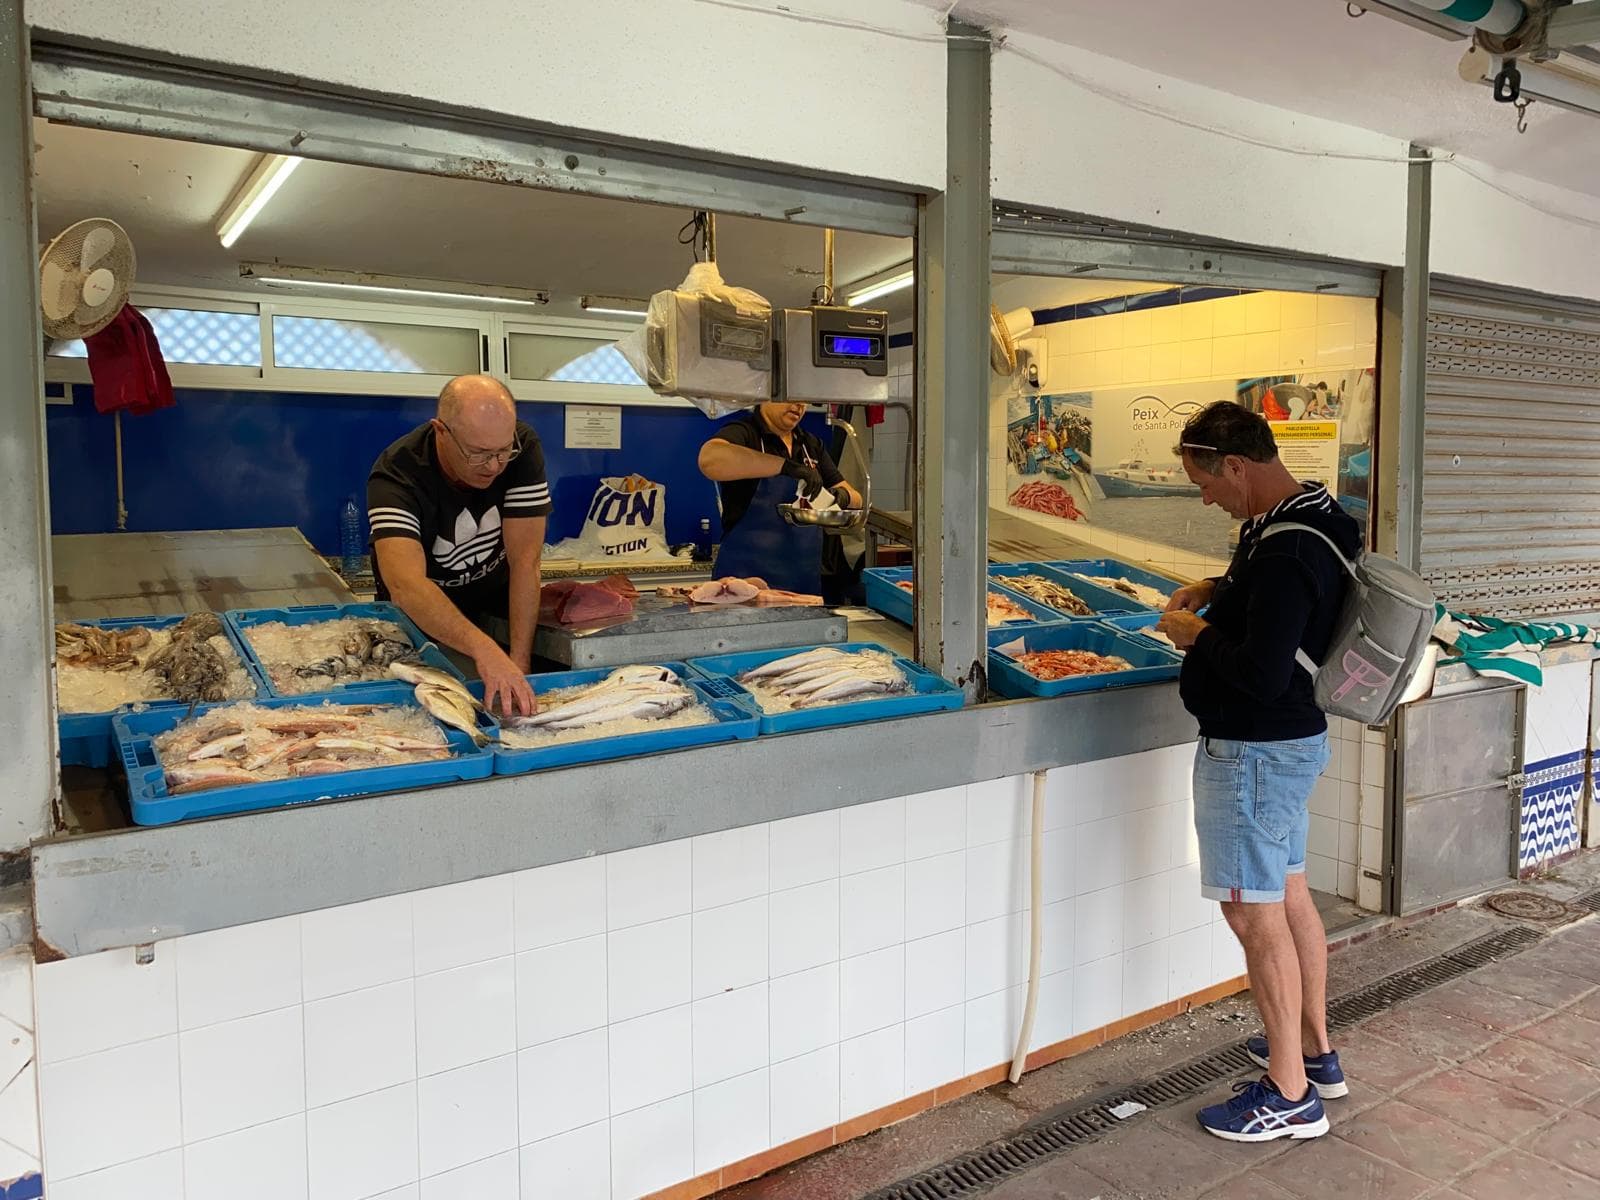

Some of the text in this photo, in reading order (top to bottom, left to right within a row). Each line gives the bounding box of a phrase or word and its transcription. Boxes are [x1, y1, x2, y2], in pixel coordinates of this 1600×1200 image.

[1133, 407, 1159, 421] Peix
[1133, 422, 1143, 431] de
[1145, 421, 1167, 430] Santa
